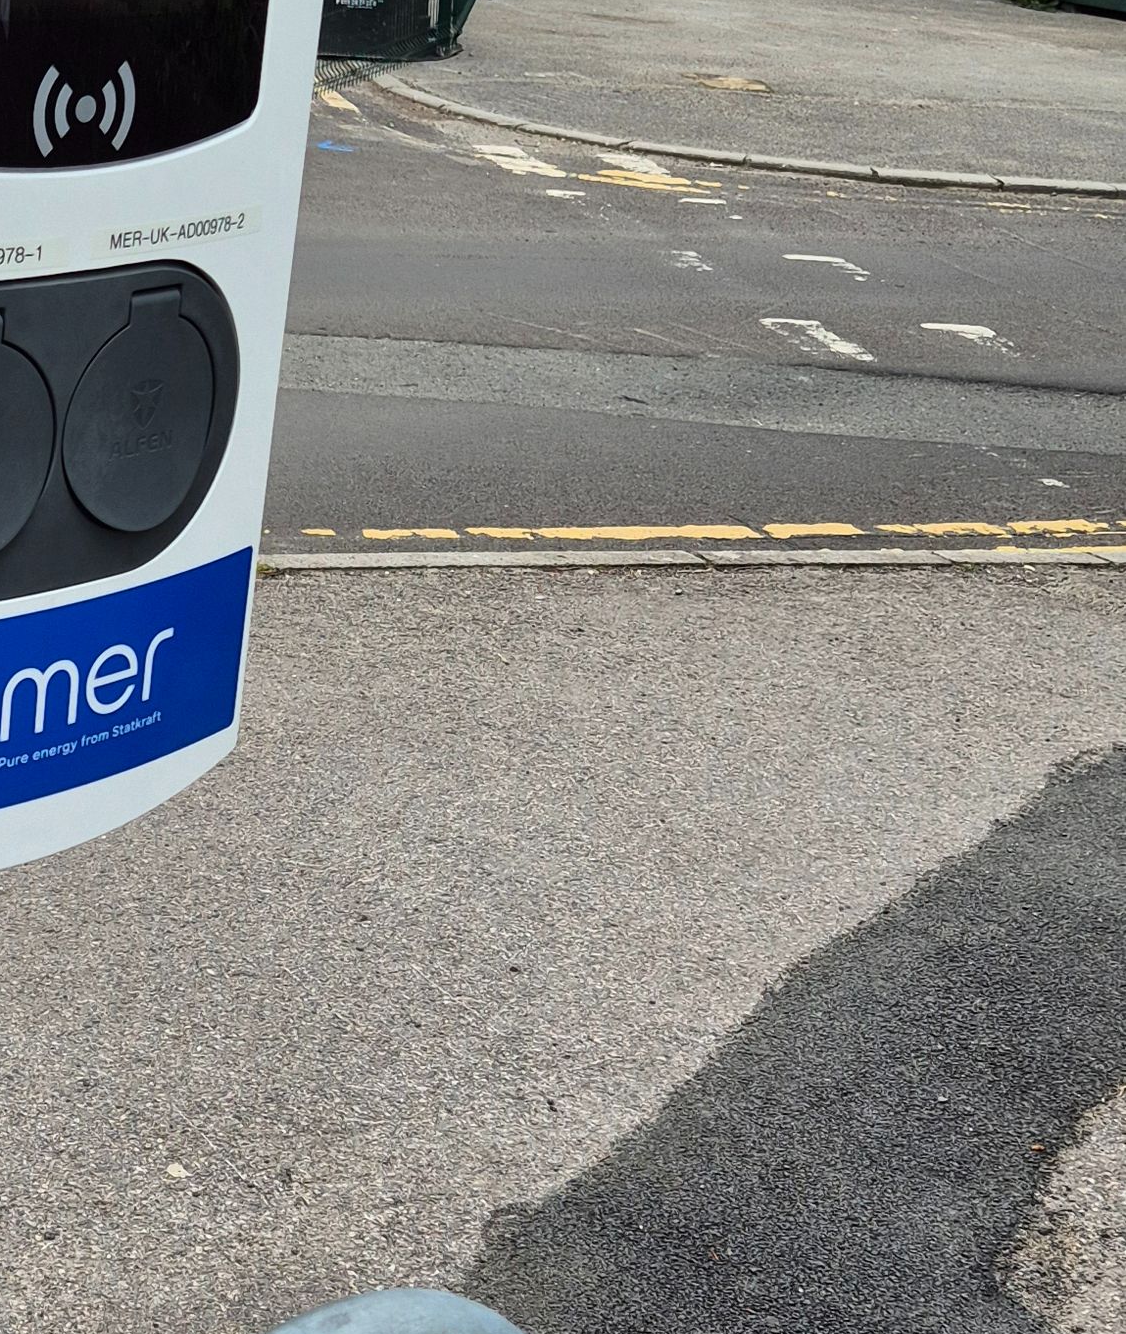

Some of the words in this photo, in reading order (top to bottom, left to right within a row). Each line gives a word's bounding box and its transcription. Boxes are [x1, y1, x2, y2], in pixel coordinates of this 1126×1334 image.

[110, 212, 245, 251] MER-UK-AD00978-2
[109, 429, 172, 462] ALFEN
[0, 627, 174, 743] mer
[32, 740, 78, 760] energy
[81, 732, 109, 747] from
[112, 711, 161, 738] Statkraft
